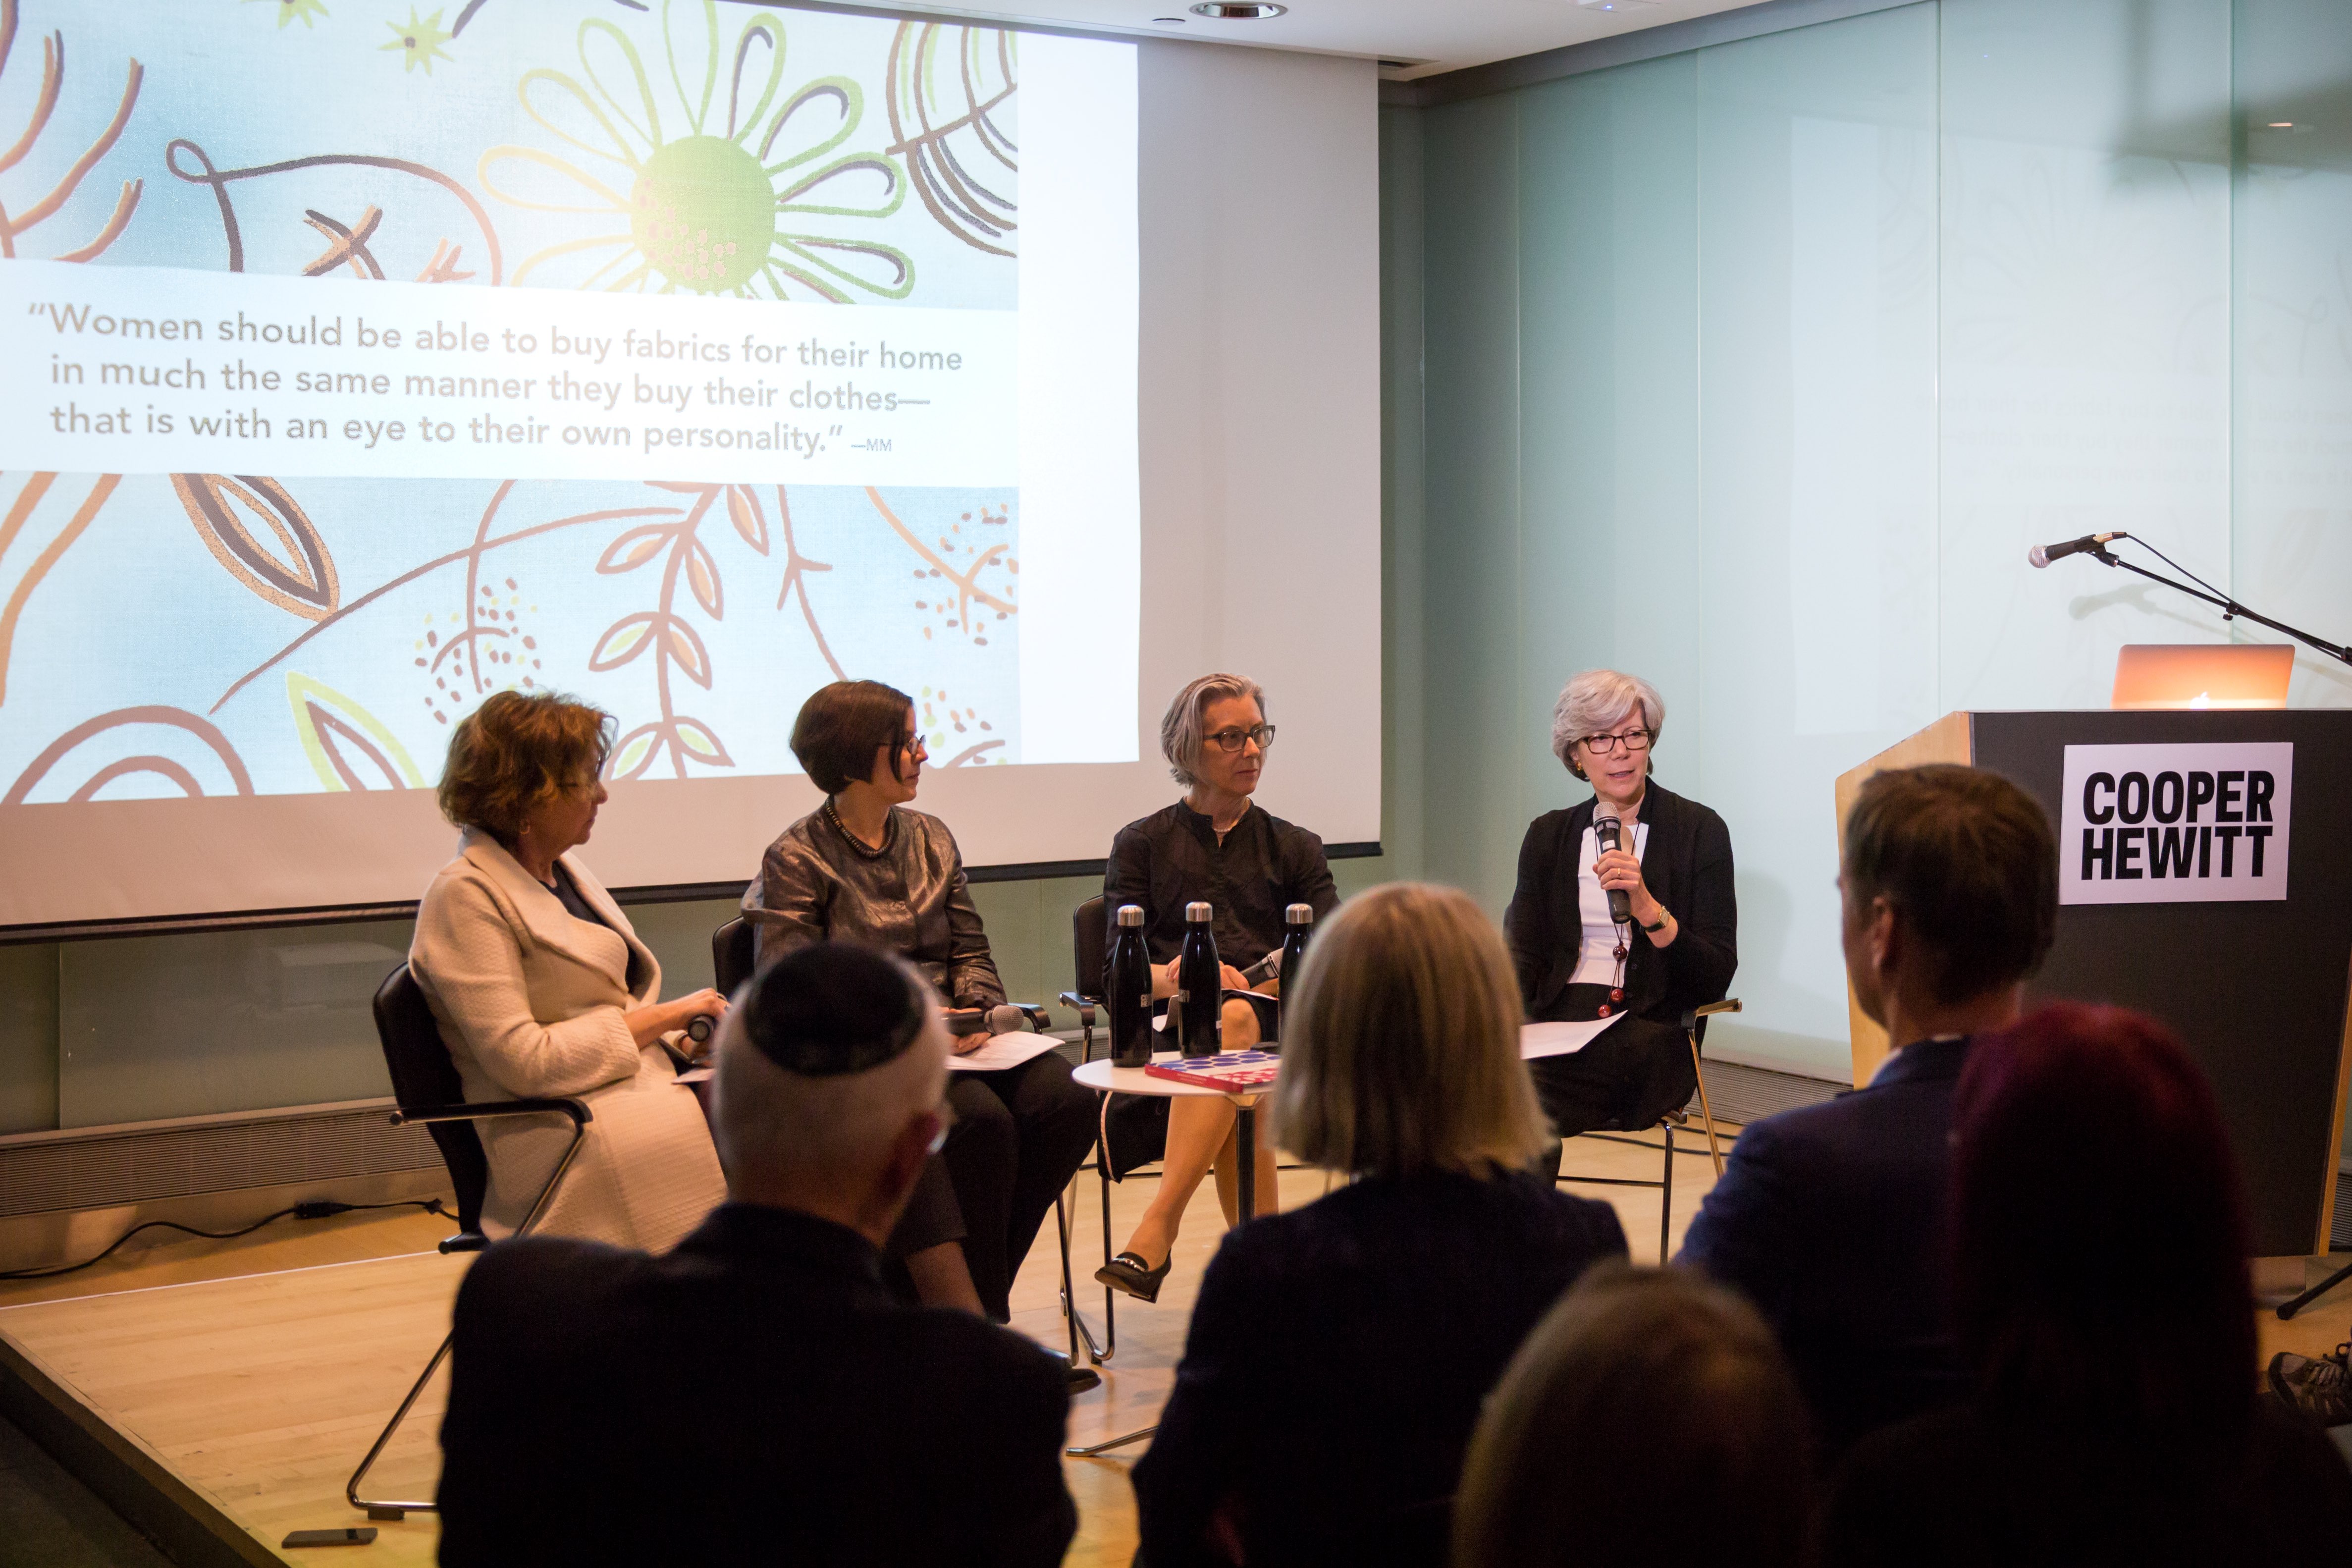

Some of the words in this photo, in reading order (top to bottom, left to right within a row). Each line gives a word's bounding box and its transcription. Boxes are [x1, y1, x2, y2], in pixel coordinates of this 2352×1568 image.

[217, 310, 342, 347] should
[357, 316, 402, 349] be
[415, 320, 490, 353] able
[501, 328, 537, 354] to
[551, 325, 612, 365] buy
[623, 328, 731, 363] fabrics
[741, 334, 788, 364] for
[797, 337, 870, 368] their
[880, 340, 962, 371] home
[51, 352, 84, 385] in
[100, 357, 207, 390] much
[219, 357, 282, 392] the
[295, 371, 391, 395] same
[404, 375, 537, 400] manner
[547, 370, 622, 411] they
[634, 373, 693, 413] buy
[703, 376, 779, 408] their
[49, 400, 132, 435] that
[146, 403, 175, 435] is
[188, 406, 272, 439] with
[285, 418, 328, 440] an
[342, 419, 406, 450] eye
[417, 416, 456, 443] to
[468, 412, 550, 444] their
[561, 425, 631, 446] own
[2083, 770, 2275, 825] COOPER
[2081, 825, 2273, 880] HEWITT
